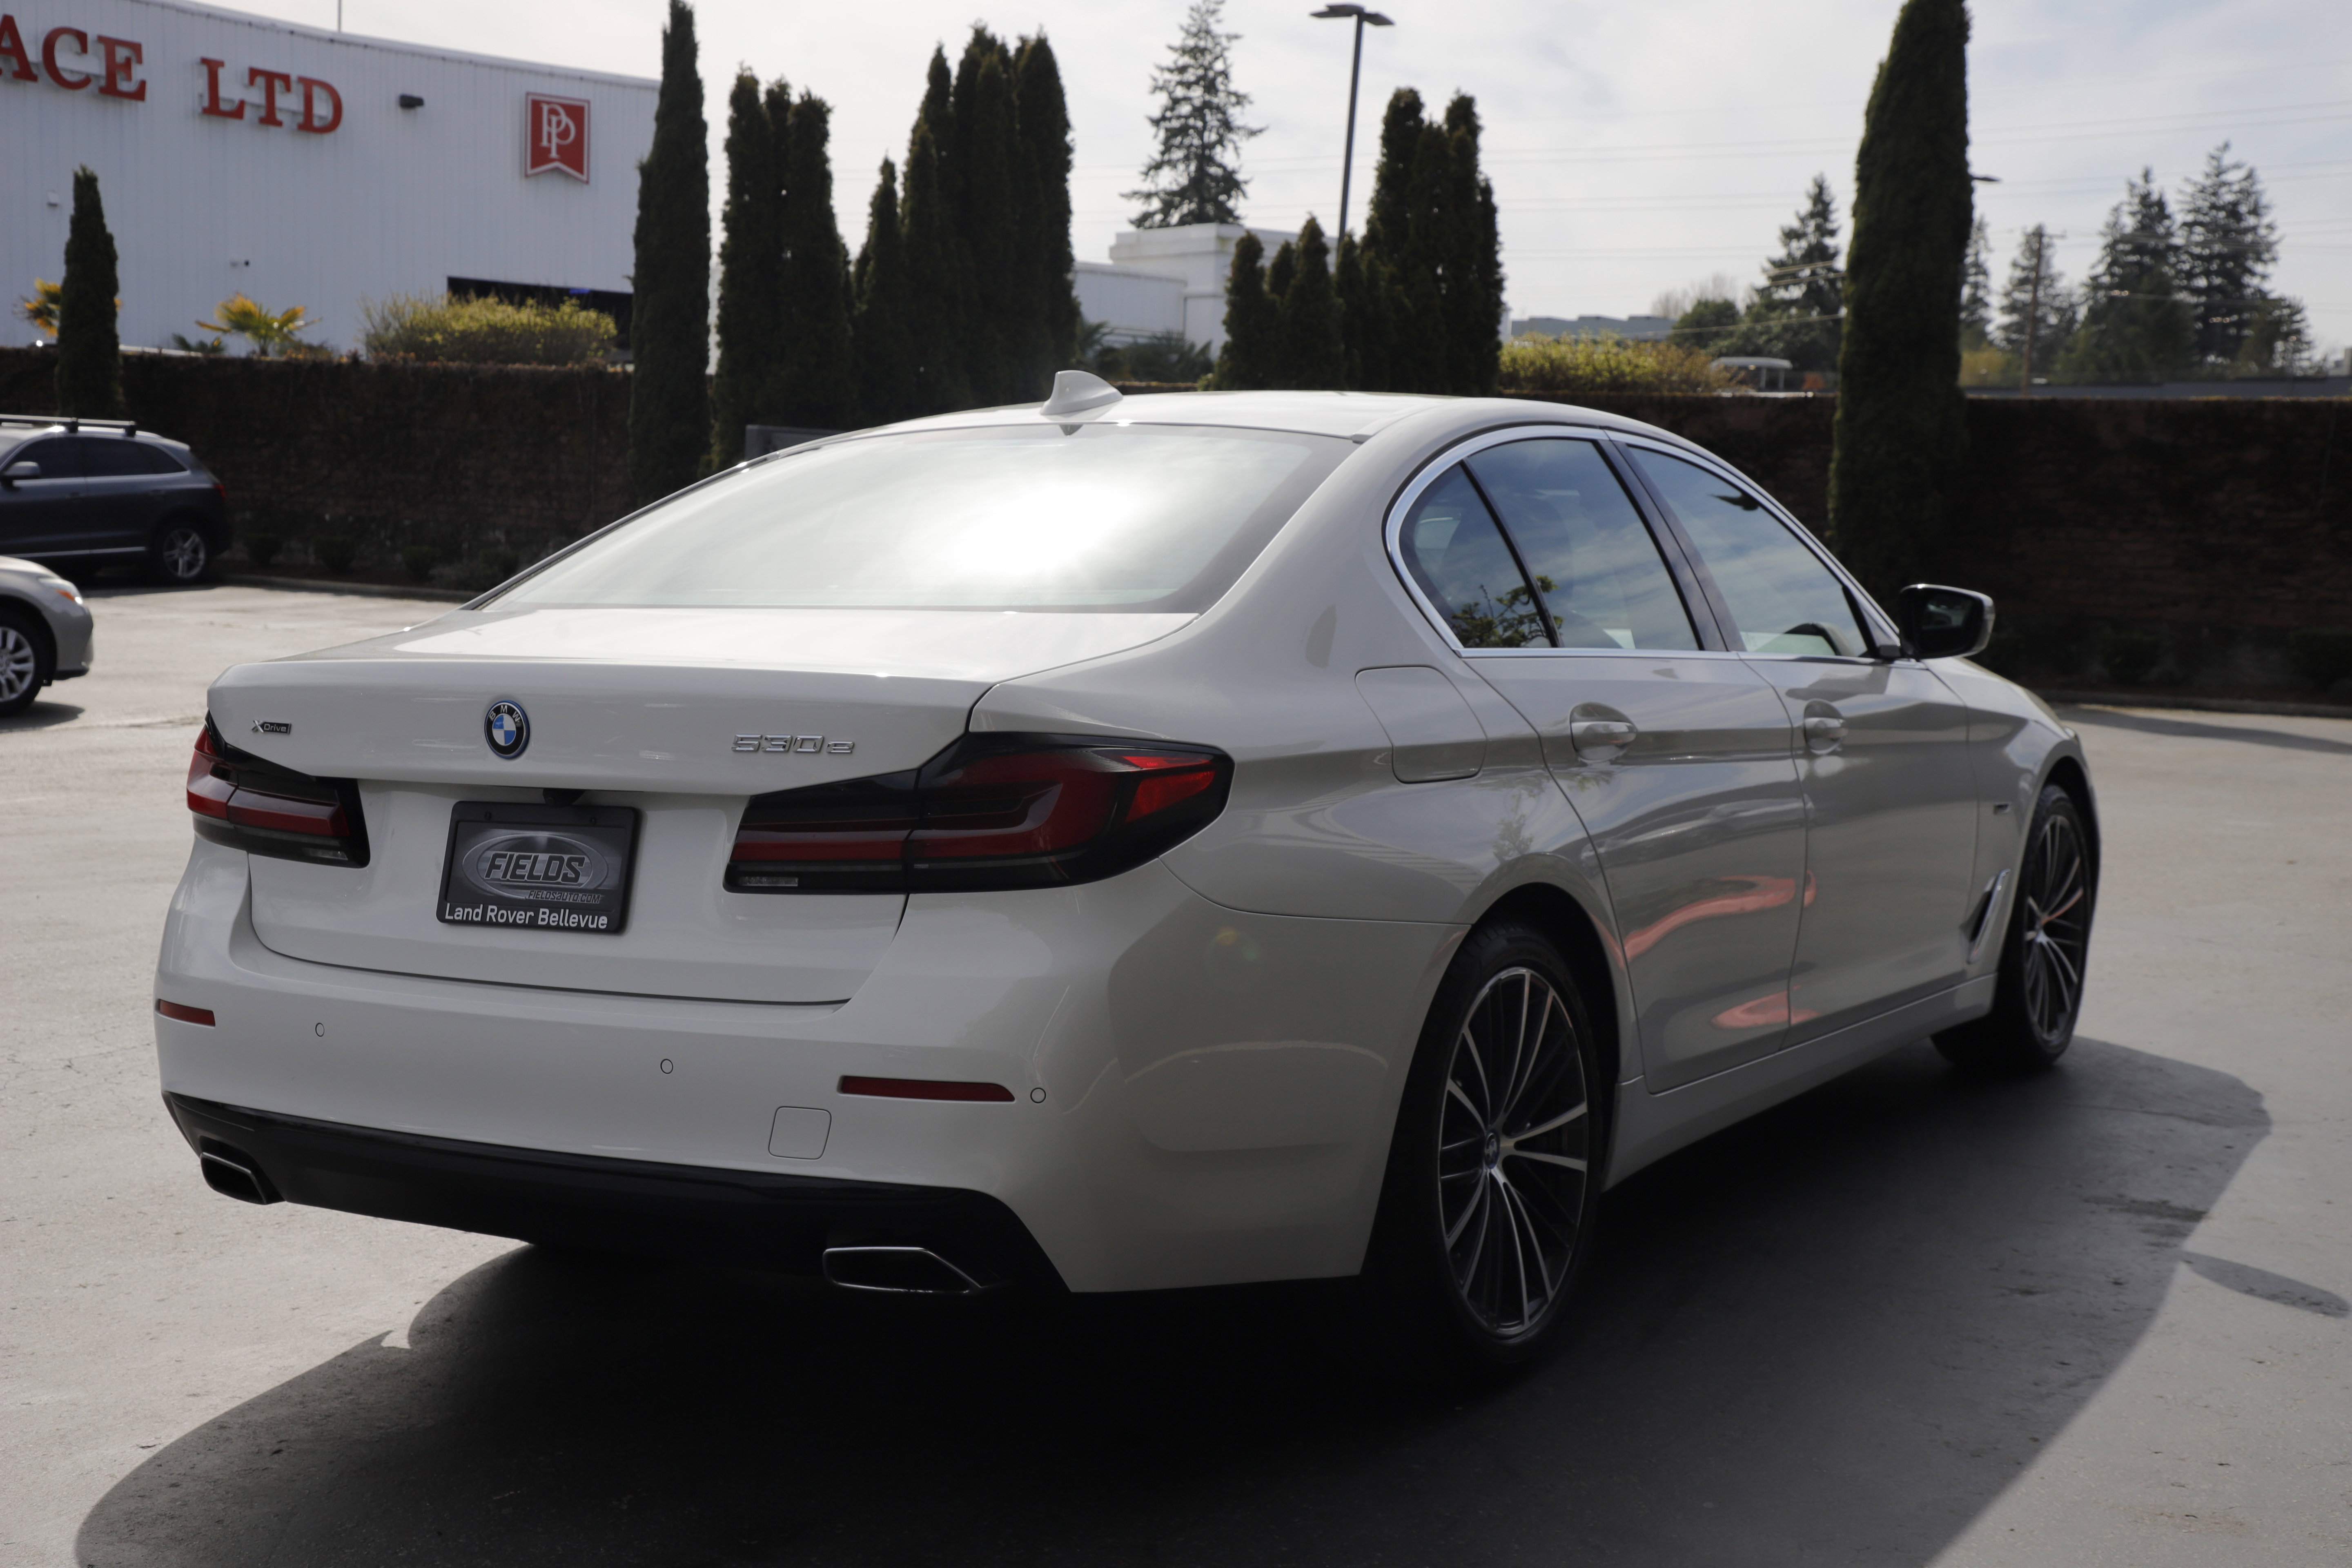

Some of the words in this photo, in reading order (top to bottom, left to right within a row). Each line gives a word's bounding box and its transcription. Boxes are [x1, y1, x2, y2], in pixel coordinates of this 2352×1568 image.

[0, 13, 146, 101] ACE
[200, 57, 343, 134] LTD
[489, 705, 522, 727] BMW
[483, 852, 586, 884] FIELDS
[445, 902, 483, 921] Land
[486, 905, 535, 924] Rover
[537, 908, 608, 929] Bellevue
